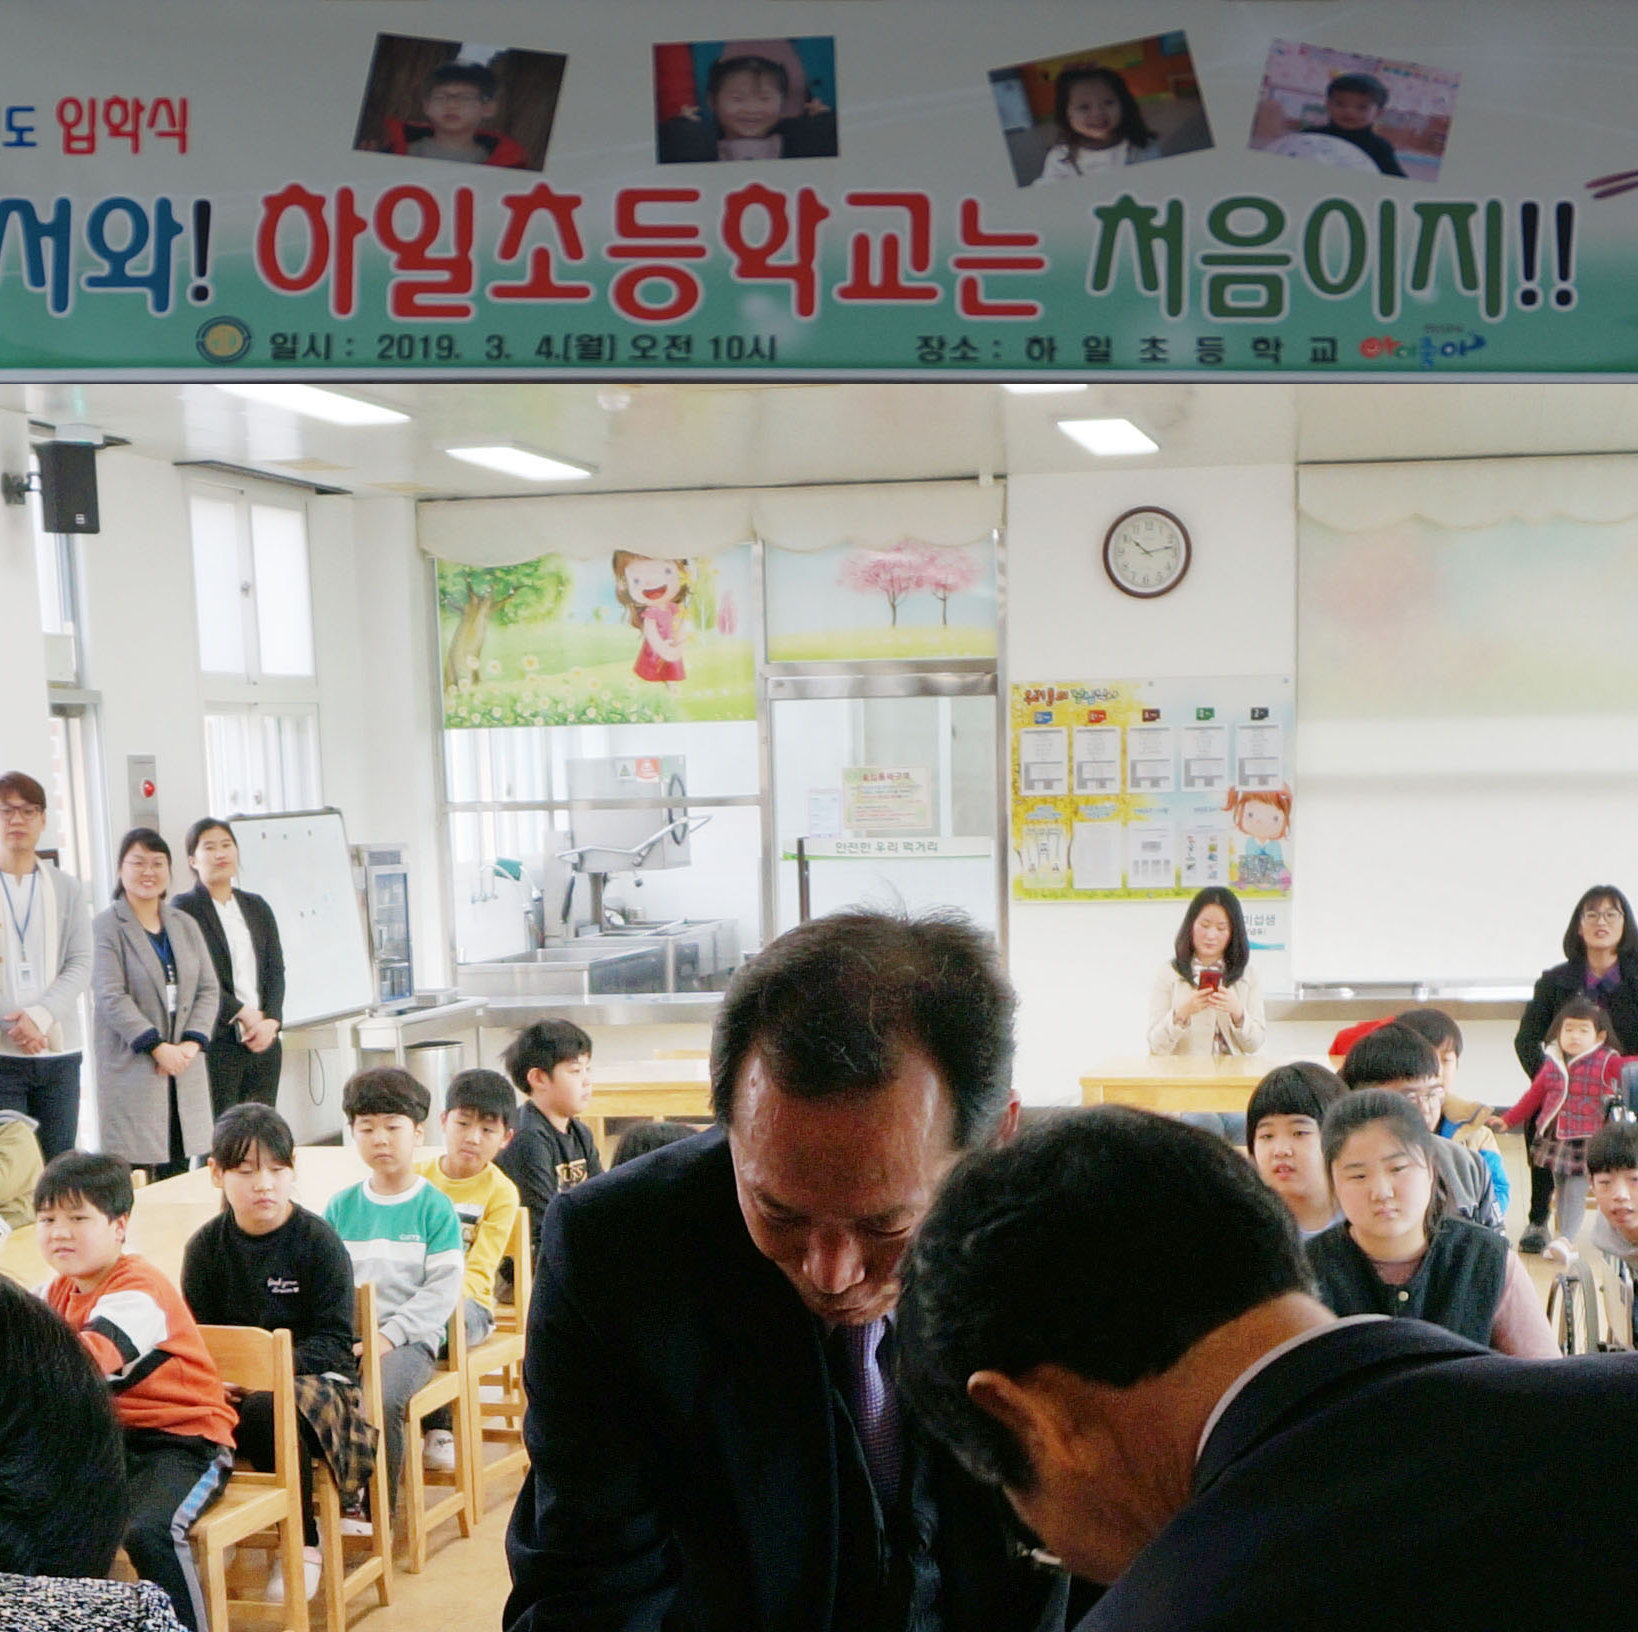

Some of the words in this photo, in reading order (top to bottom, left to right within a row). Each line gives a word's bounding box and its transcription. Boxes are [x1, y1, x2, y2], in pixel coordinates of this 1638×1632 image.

[55, 95, 190, 155] 입학식
[255, 181, 1051, 320] 하일초등학교는
[1090, 194, 1575, 319] 처음이지!!
[376, 334, 461, 362] 2019.
[484, 334, 512, 362] 3.
[629, 333, 694, 363] 오전
[709, 333, 778, 364] 10시
